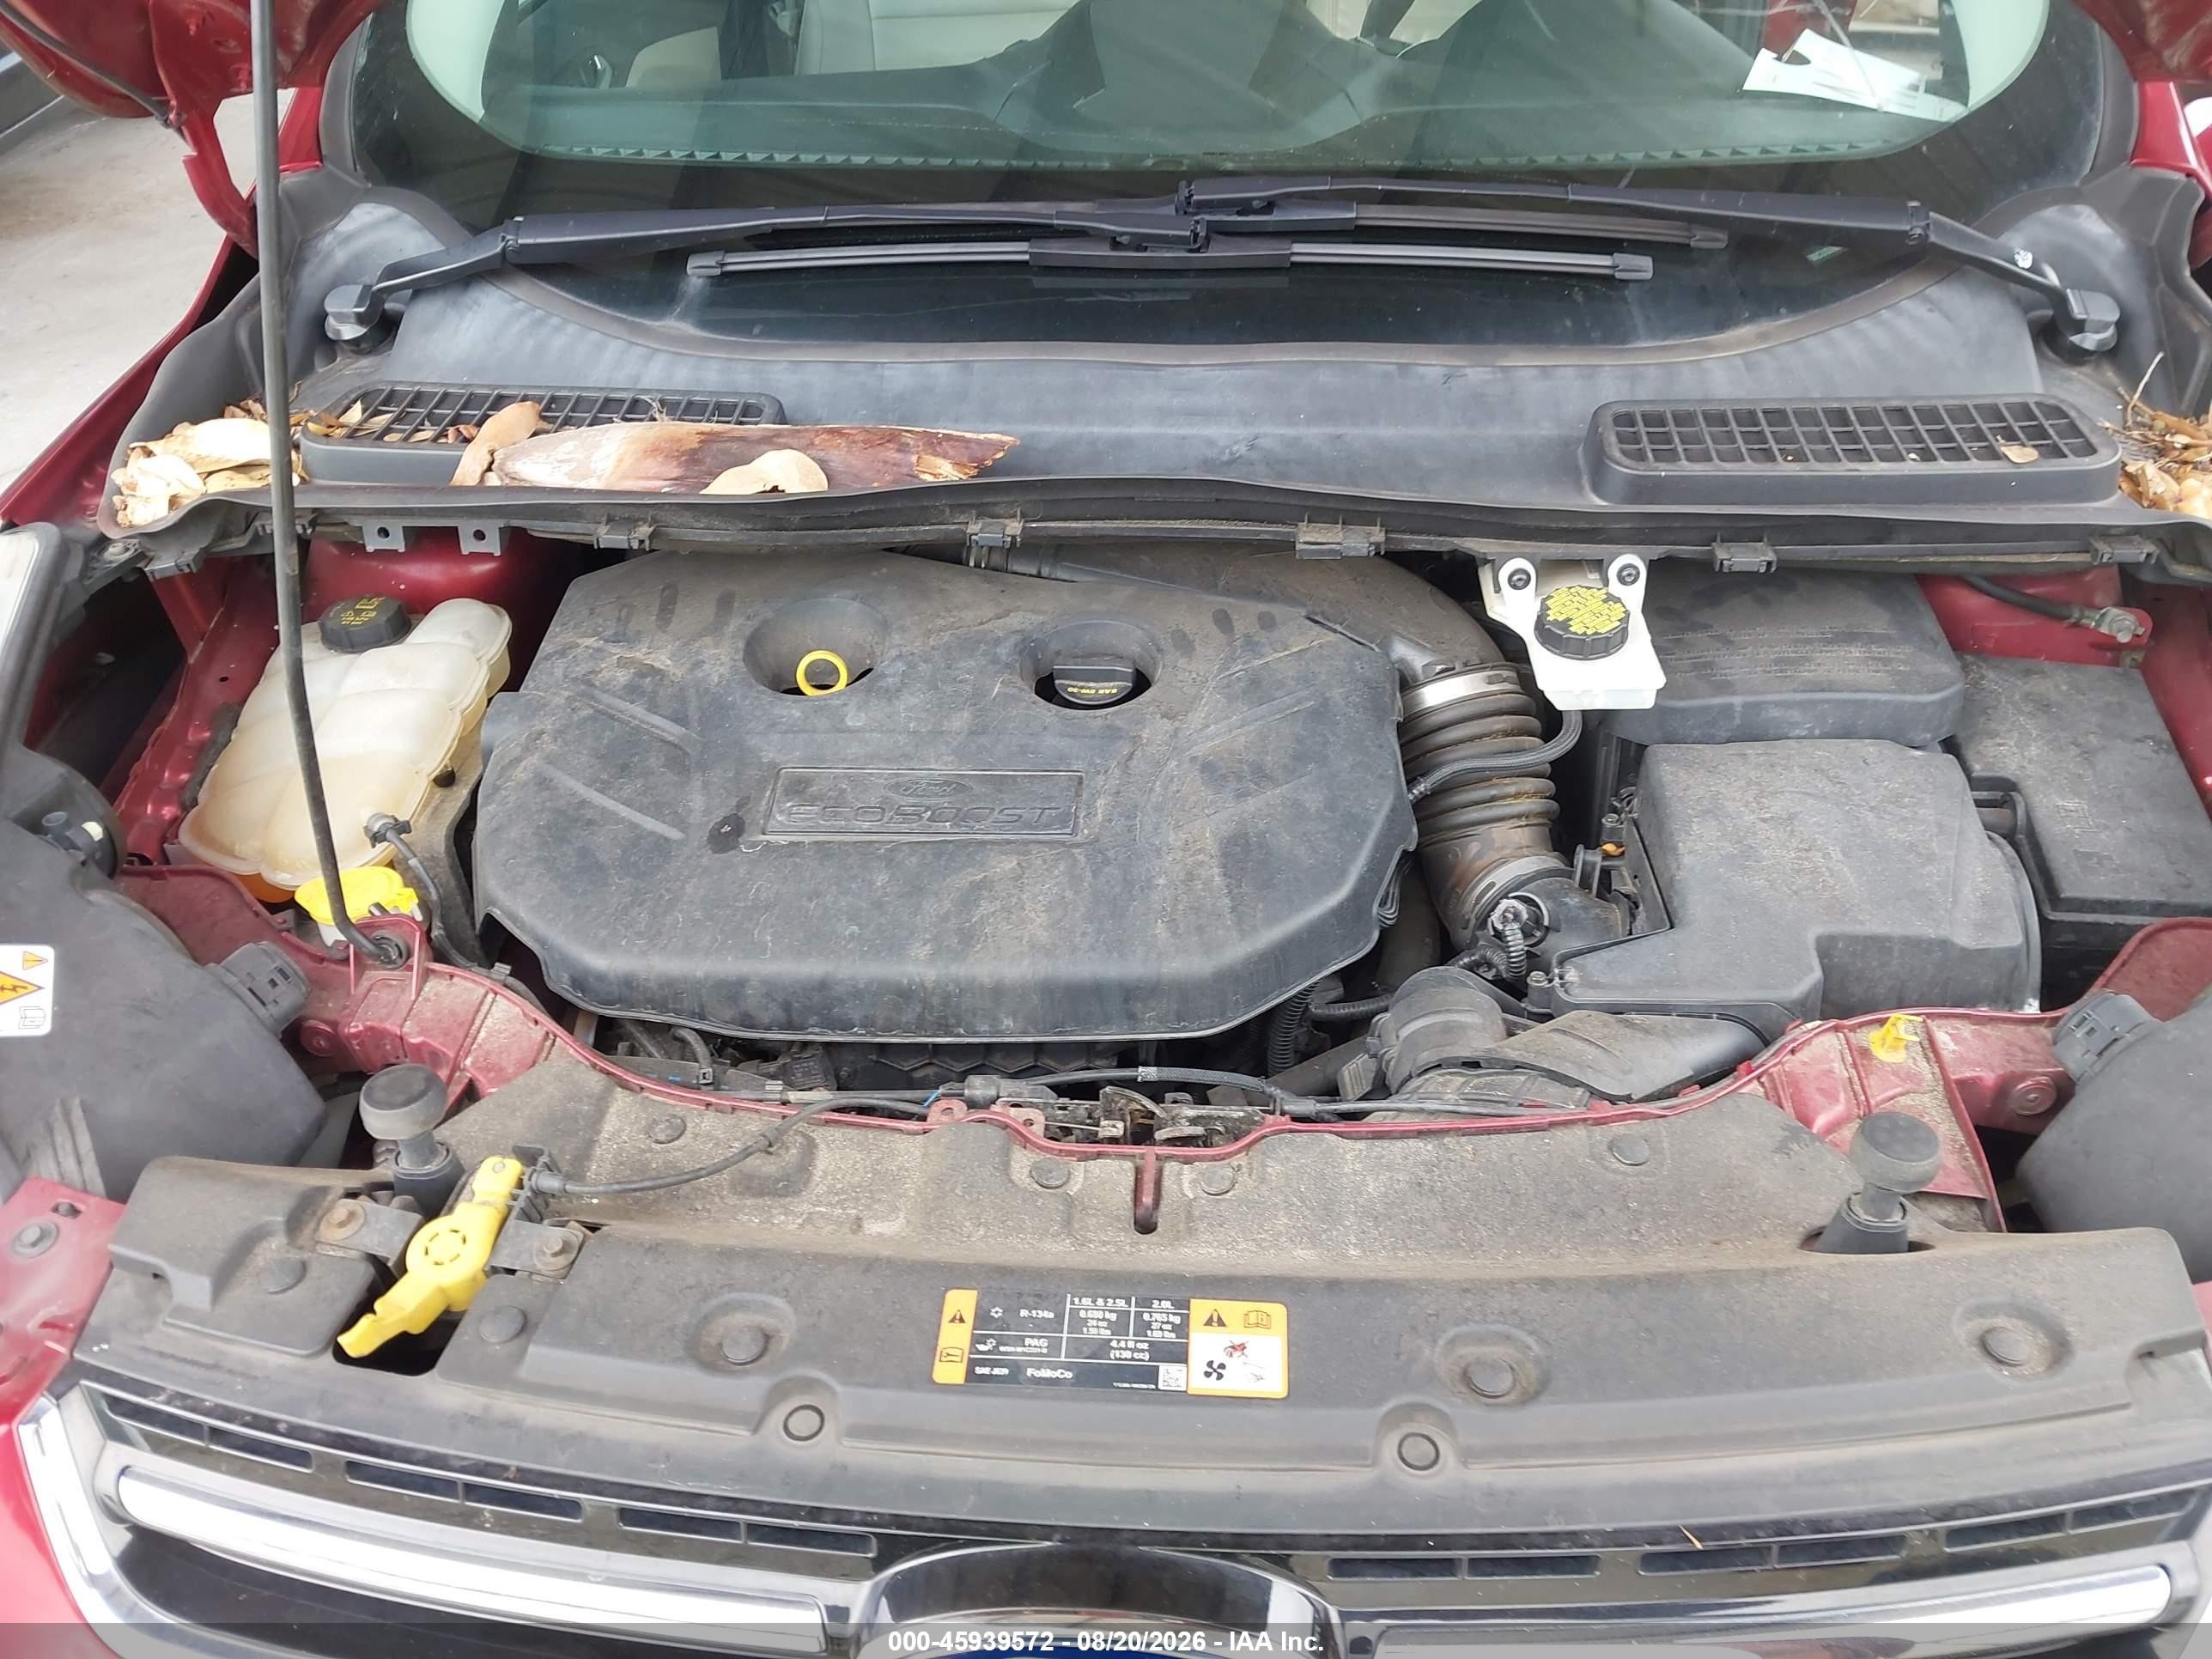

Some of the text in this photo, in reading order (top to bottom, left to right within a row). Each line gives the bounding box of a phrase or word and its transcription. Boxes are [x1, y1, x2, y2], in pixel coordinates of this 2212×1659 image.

[900, 781, 957, 795] Ford
[786, 805, 1061, 825] ECOBOOST
[1073, 1297, 1129, 1308] 1.6L & 2.5L
[1152, 1299, 1176, 1310] 2.0L
[1019, 1309, 1055, 1319] R-134a
[1104, 1310, 1117, 1322] kg
[1143, 1312, 1182, 1324] 0.765 kg
[1024, 1337, 1048, 1347] PAG
[1109, 1340, 1127, 1349] 4.4
[1109, 1350, 1150, 1361] (130 cc)
[1026, 1367, 1073, 1379] FoMoCo
